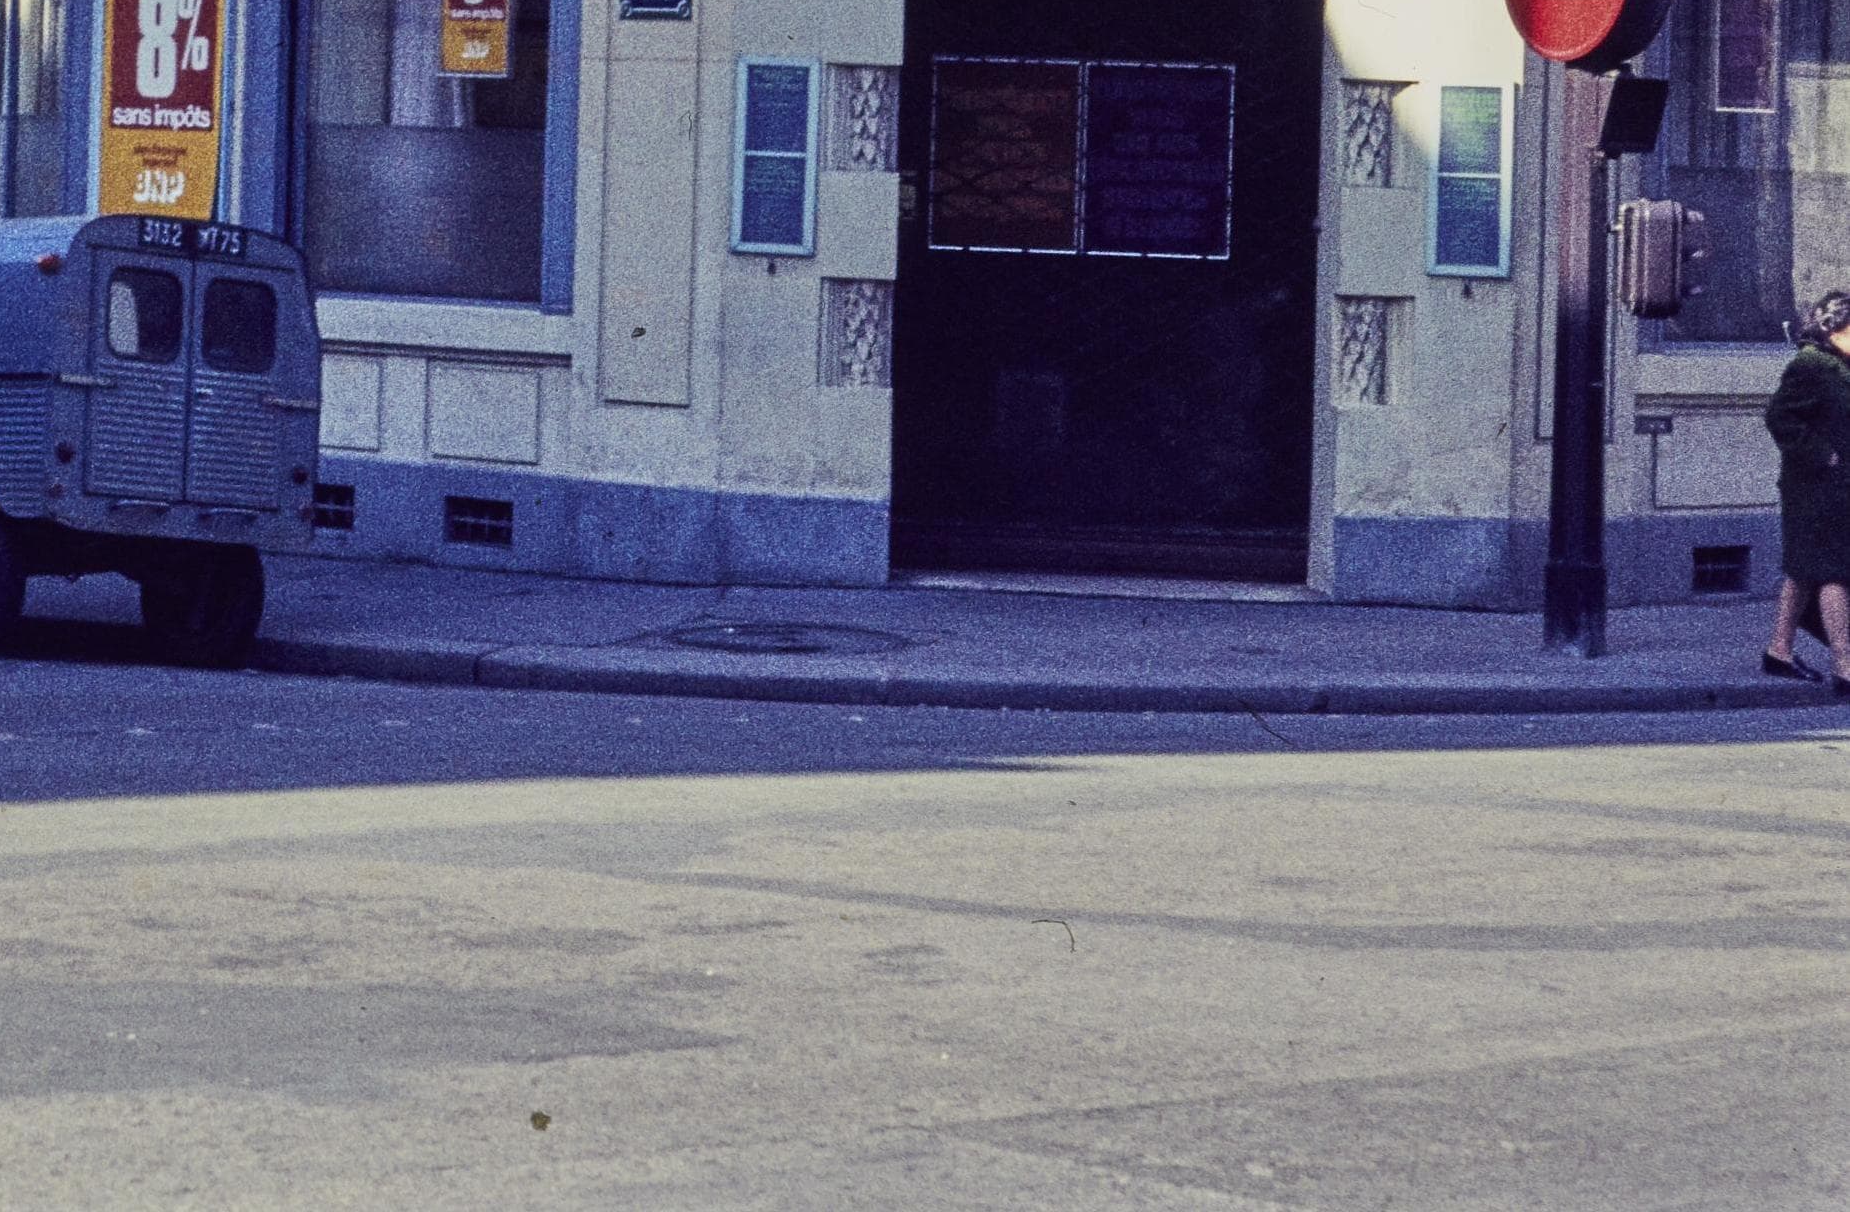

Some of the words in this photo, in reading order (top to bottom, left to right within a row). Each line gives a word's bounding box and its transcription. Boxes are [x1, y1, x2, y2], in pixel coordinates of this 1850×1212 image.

[113, 107, 151, 126] sans
[154, 104, 211, 130] impôts
[143, 219, 182, 247] 3132
